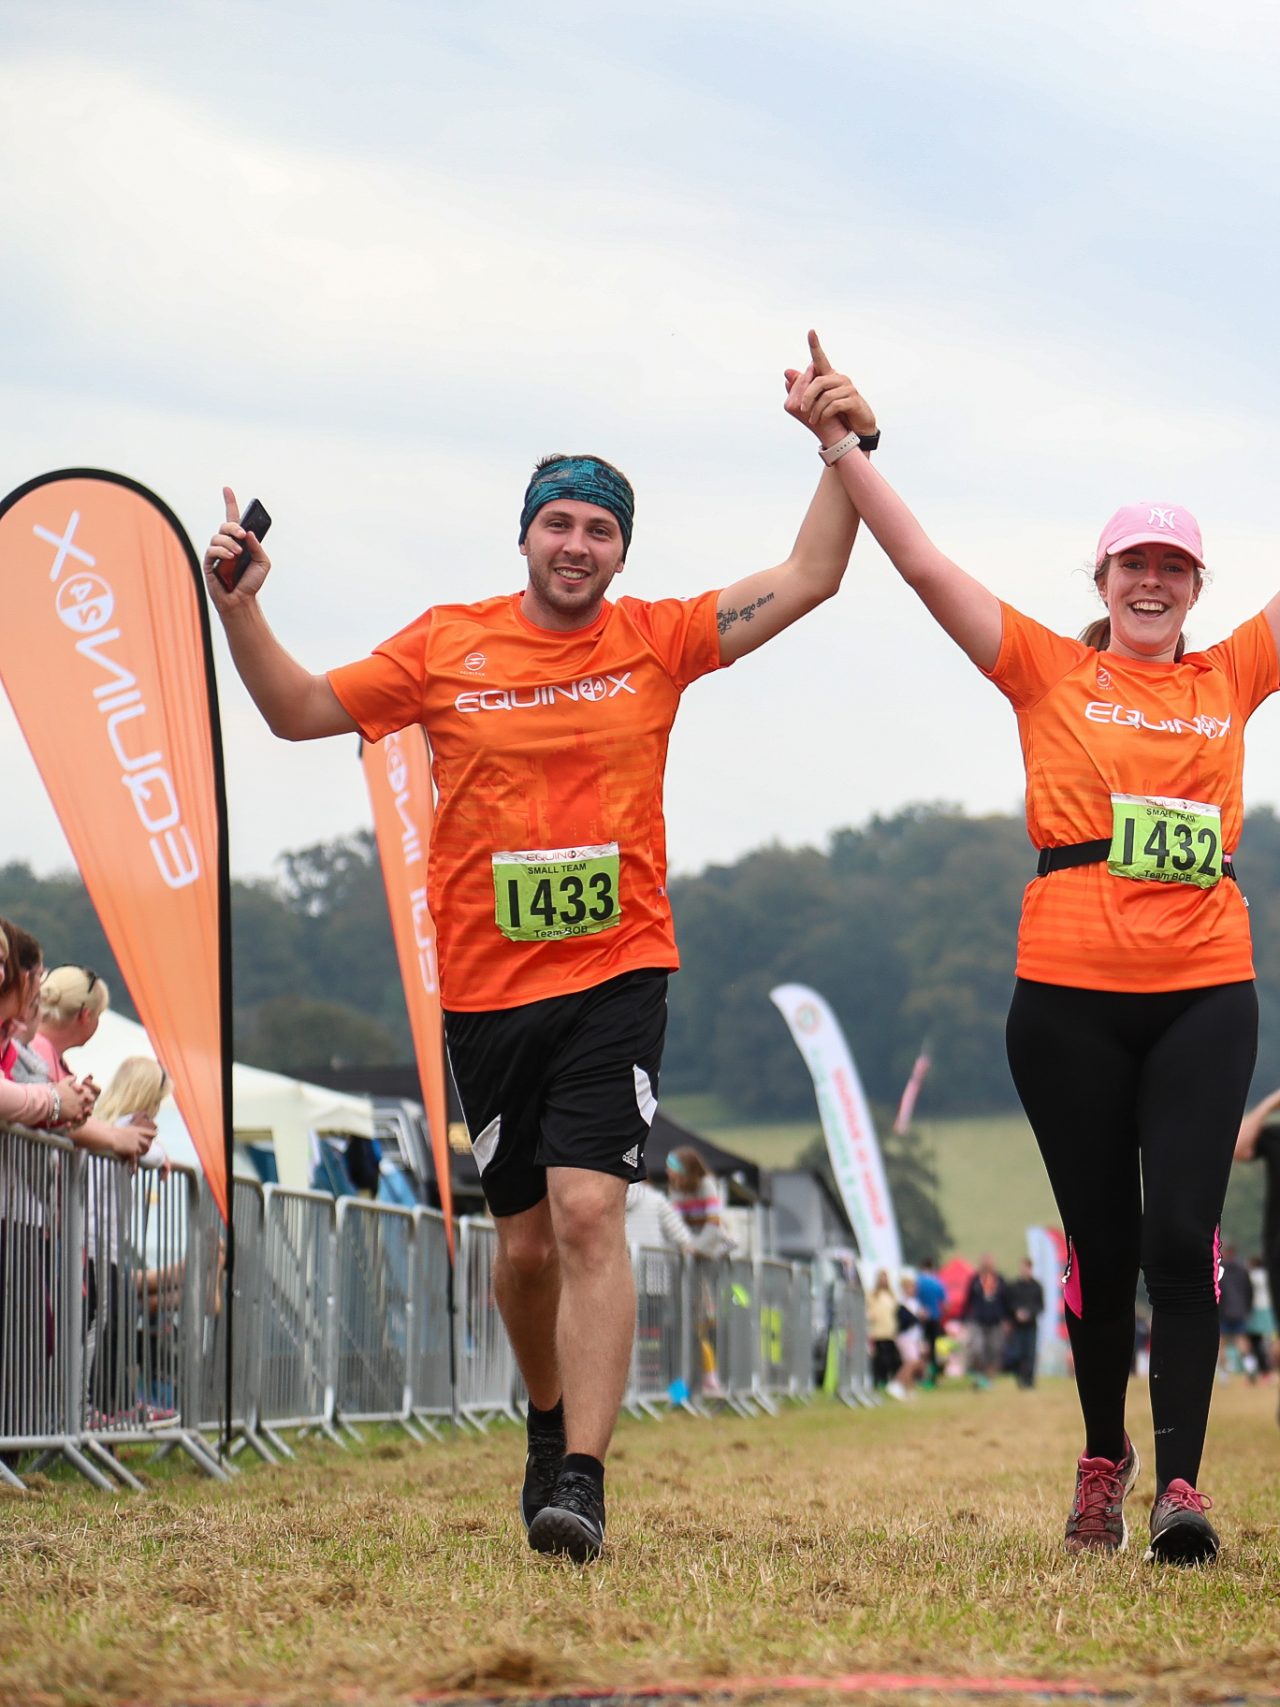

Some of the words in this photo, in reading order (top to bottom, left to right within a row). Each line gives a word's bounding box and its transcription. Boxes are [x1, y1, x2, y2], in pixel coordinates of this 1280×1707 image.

[1147, 507, 1176, 530] NY
[454, 672, 637, 713] EQUINOX
[1085, 701, 1232, 739] EQUINOX
[1146, 808, 1174, 818] SMALL
[1176, 812, 1196, 823] TEAM
[526, 850, 587, 862] EQUINOX
[1123, 818, 1217, 877] 1432
[528, 865, 559, 875] SMALL
[562, 863, 587, 873] TEAM
[1144, 870, 1169, 880] Team
[1171, 873, 1192, 882] BOB
[507, 872, 614, 928] 1433
[534, 929, 563, 938] Team
[564, 925, 588, 936] BOB
